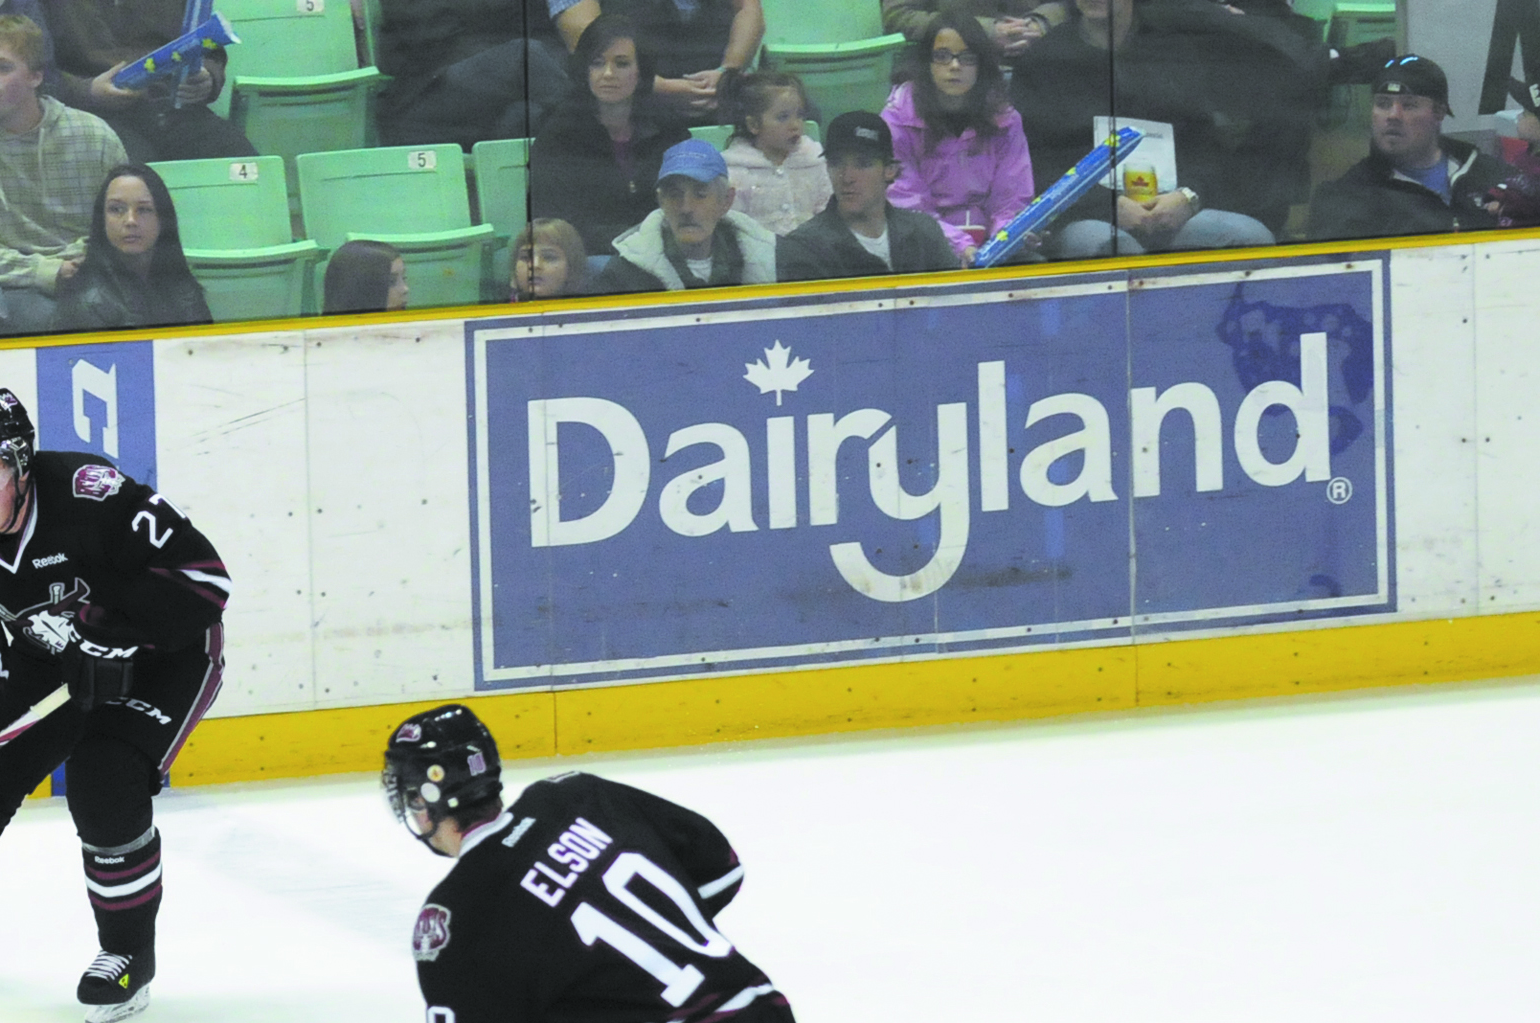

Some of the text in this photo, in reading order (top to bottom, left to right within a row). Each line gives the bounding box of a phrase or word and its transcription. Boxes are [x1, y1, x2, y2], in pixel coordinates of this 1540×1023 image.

[417, 152, 426, 167] 5
[238, 164, 247, 179] 4
[528, 333, 1331, 603] Dairyland
[31, 552, 69, 570] Reebok
[94, 855, 125, 864] Reebok
[519, 816, 613, 908] ELSON
[570, 852, 736, 1008] 10
